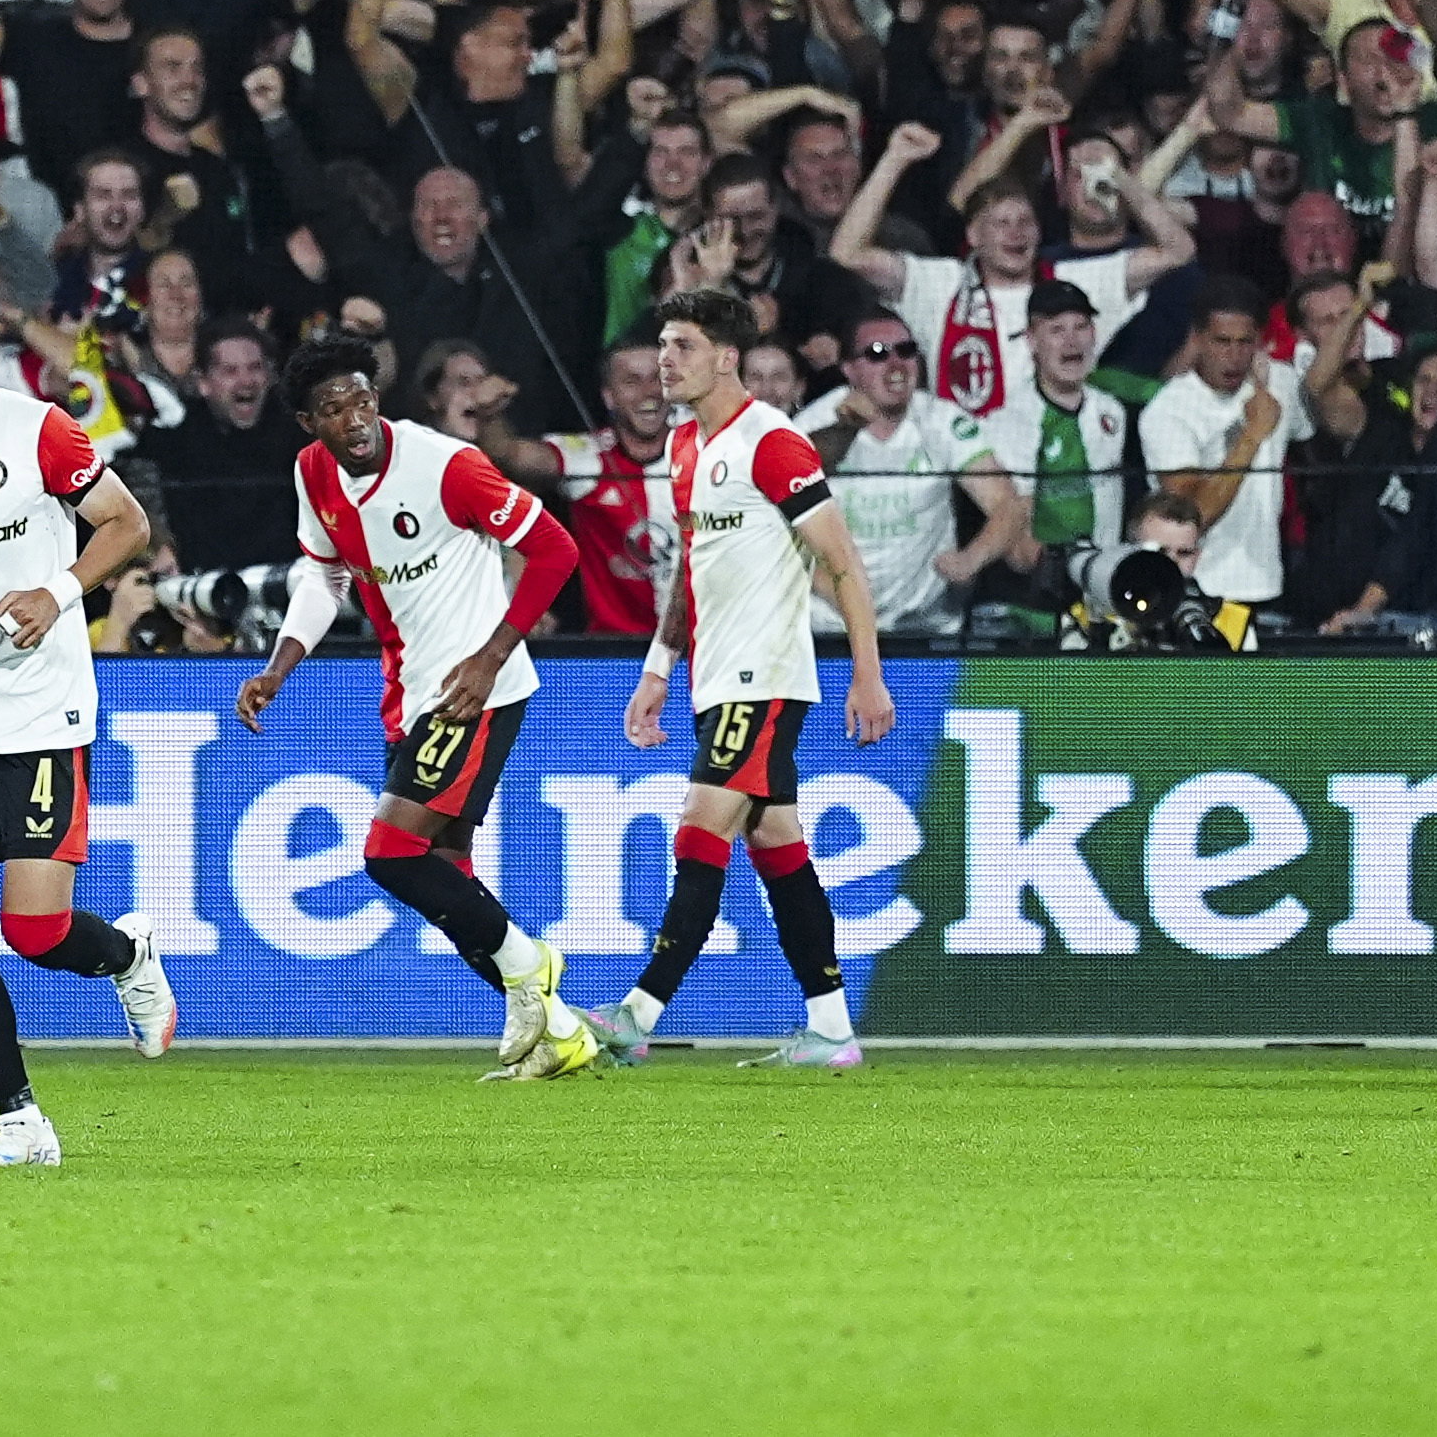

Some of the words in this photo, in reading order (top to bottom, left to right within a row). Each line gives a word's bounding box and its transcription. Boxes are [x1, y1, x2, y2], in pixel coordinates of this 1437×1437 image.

[388, 554, 439, 585] Markt
[416, 719, 466, 770] 27
[713, 703, 754, 752] 15
[29, 758, 54, 812] 4
